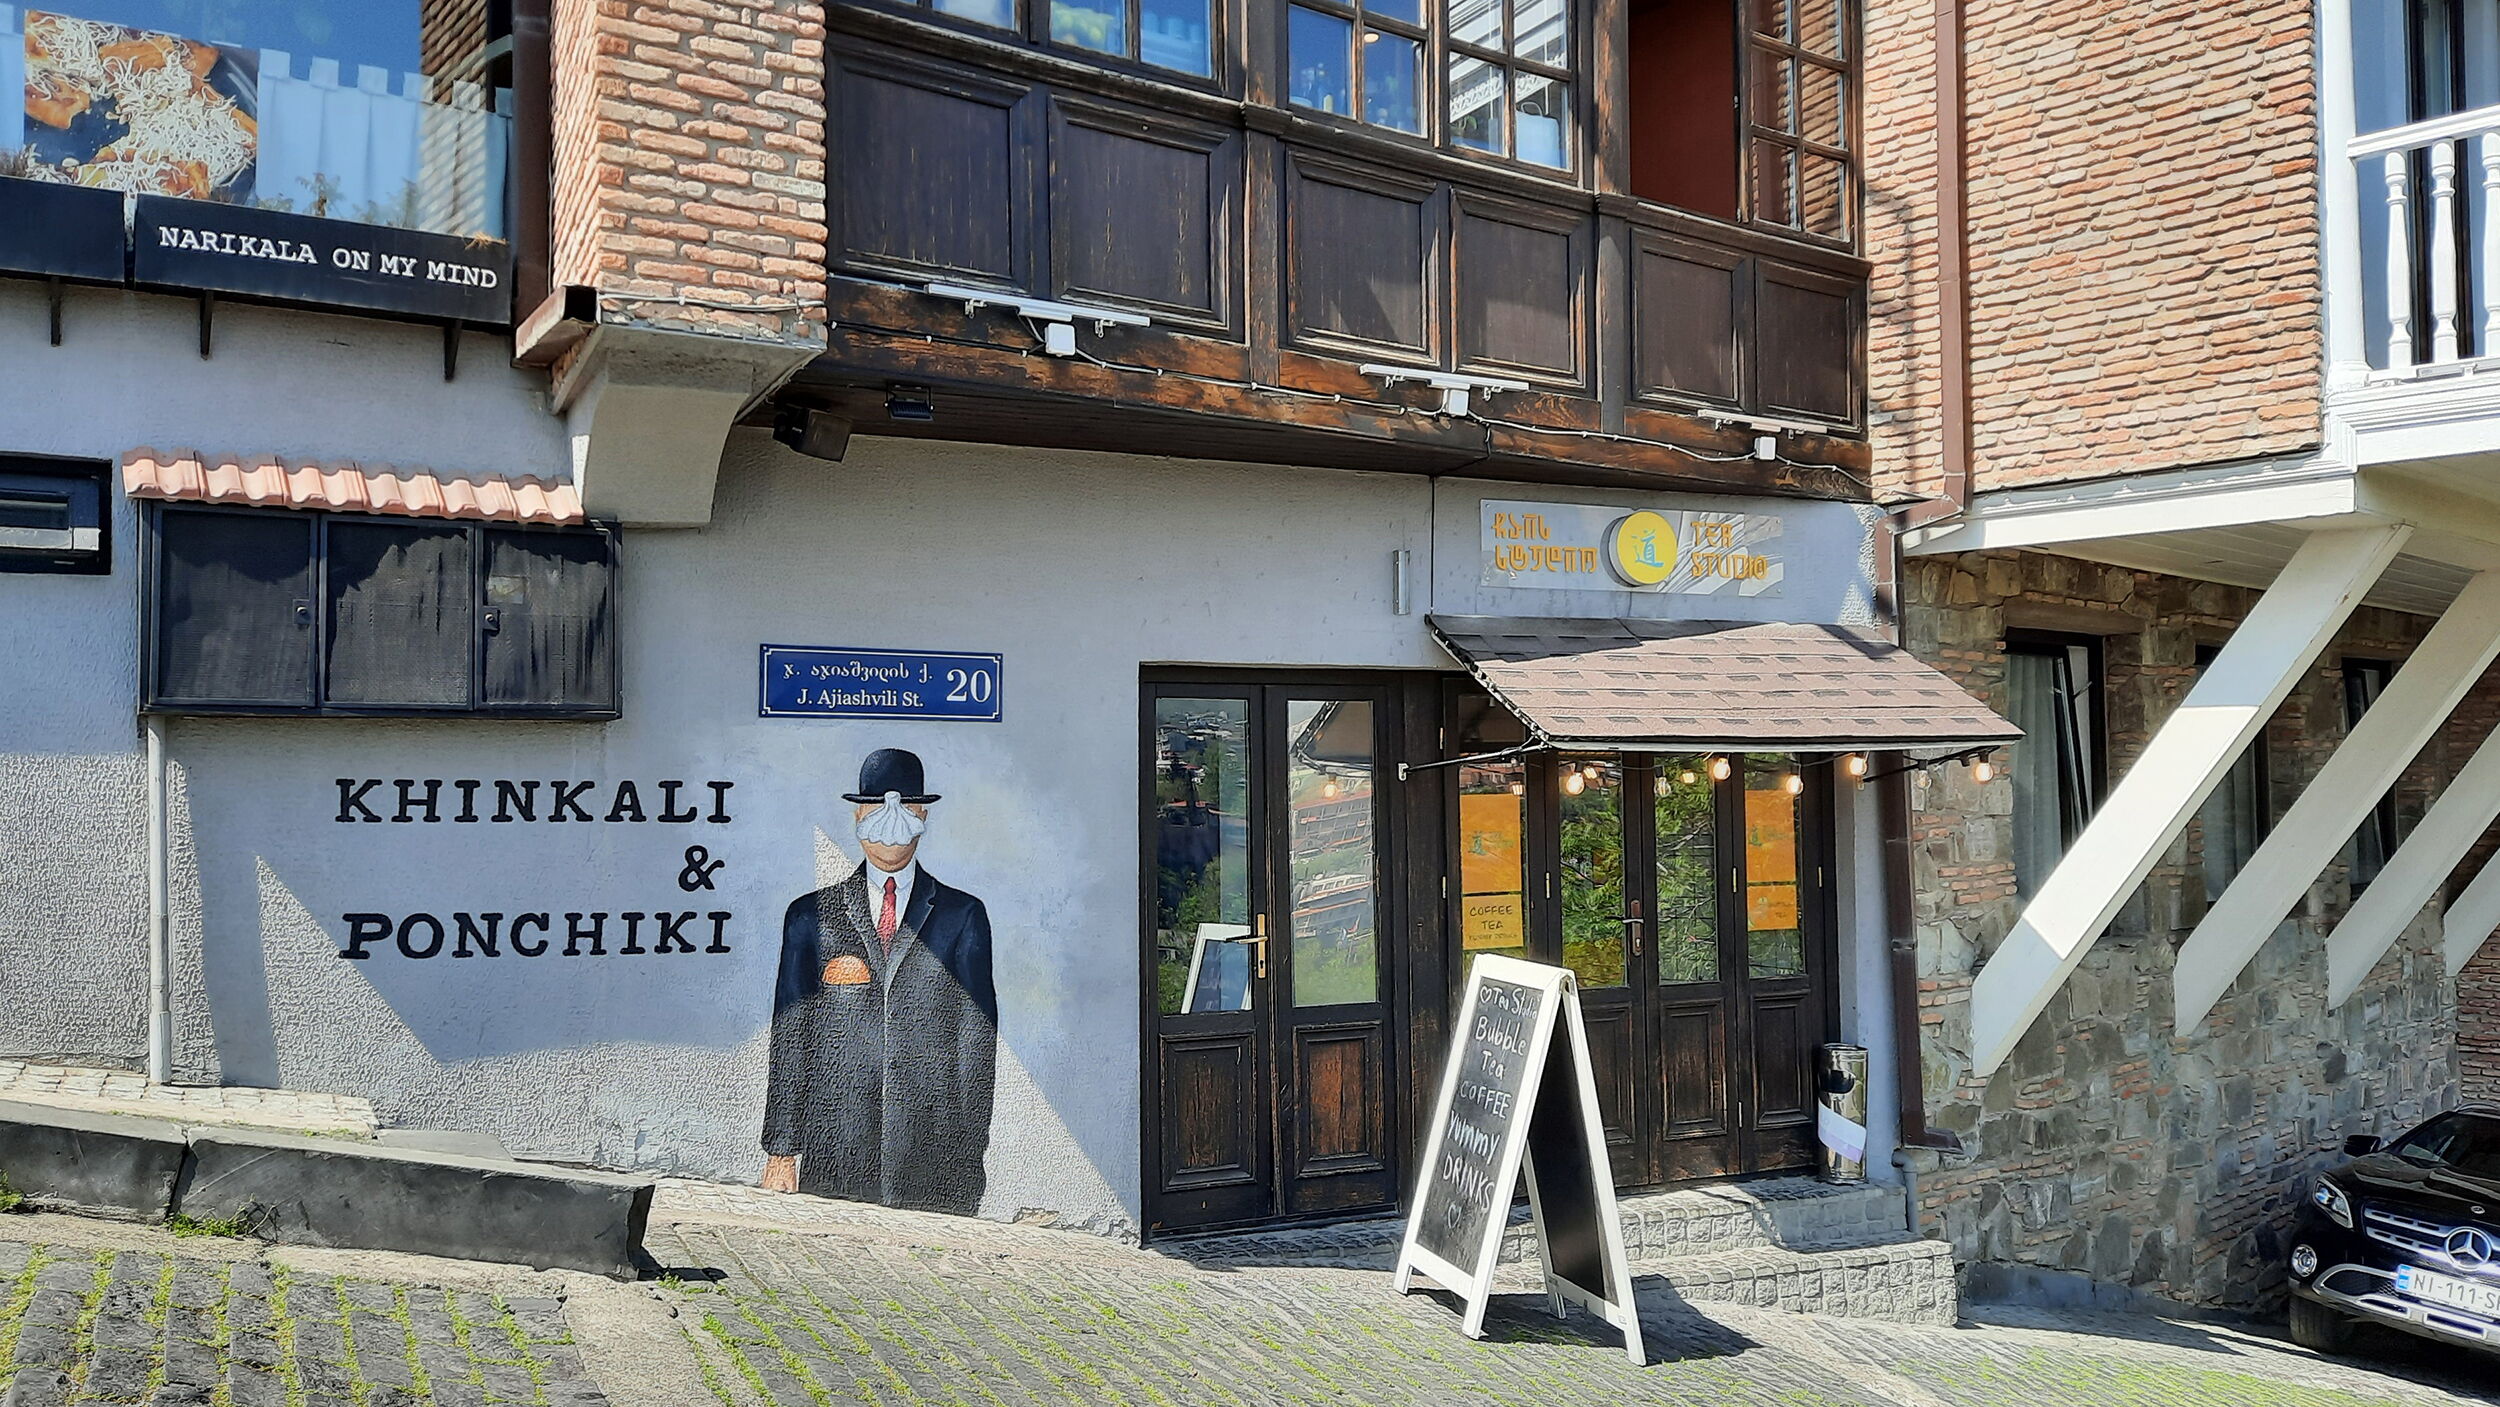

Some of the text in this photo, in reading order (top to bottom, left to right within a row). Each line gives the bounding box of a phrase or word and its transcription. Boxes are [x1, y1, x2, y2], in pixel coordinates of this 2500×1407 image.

[158, 225, 498, 289] NARIKALA ON MY MIND
[1691, 551, 1769, 580] STUDIO
[796, 688, 924, 709] J. Ajiashvili St.
[946, 669, 992, 703] 20
[335, 778, 734, 824] KHINKALI
[677, 844, 726, 892] &
[1469, 904, 1514, 917] COFFEE
[1481, 919, 1504, 930] TEA
[338, 911, 733, 960] PONCHIKI
[1481, 1050, 1506, 1080] Tea
[1442, 1150, 1495, 1214] DRINKS
